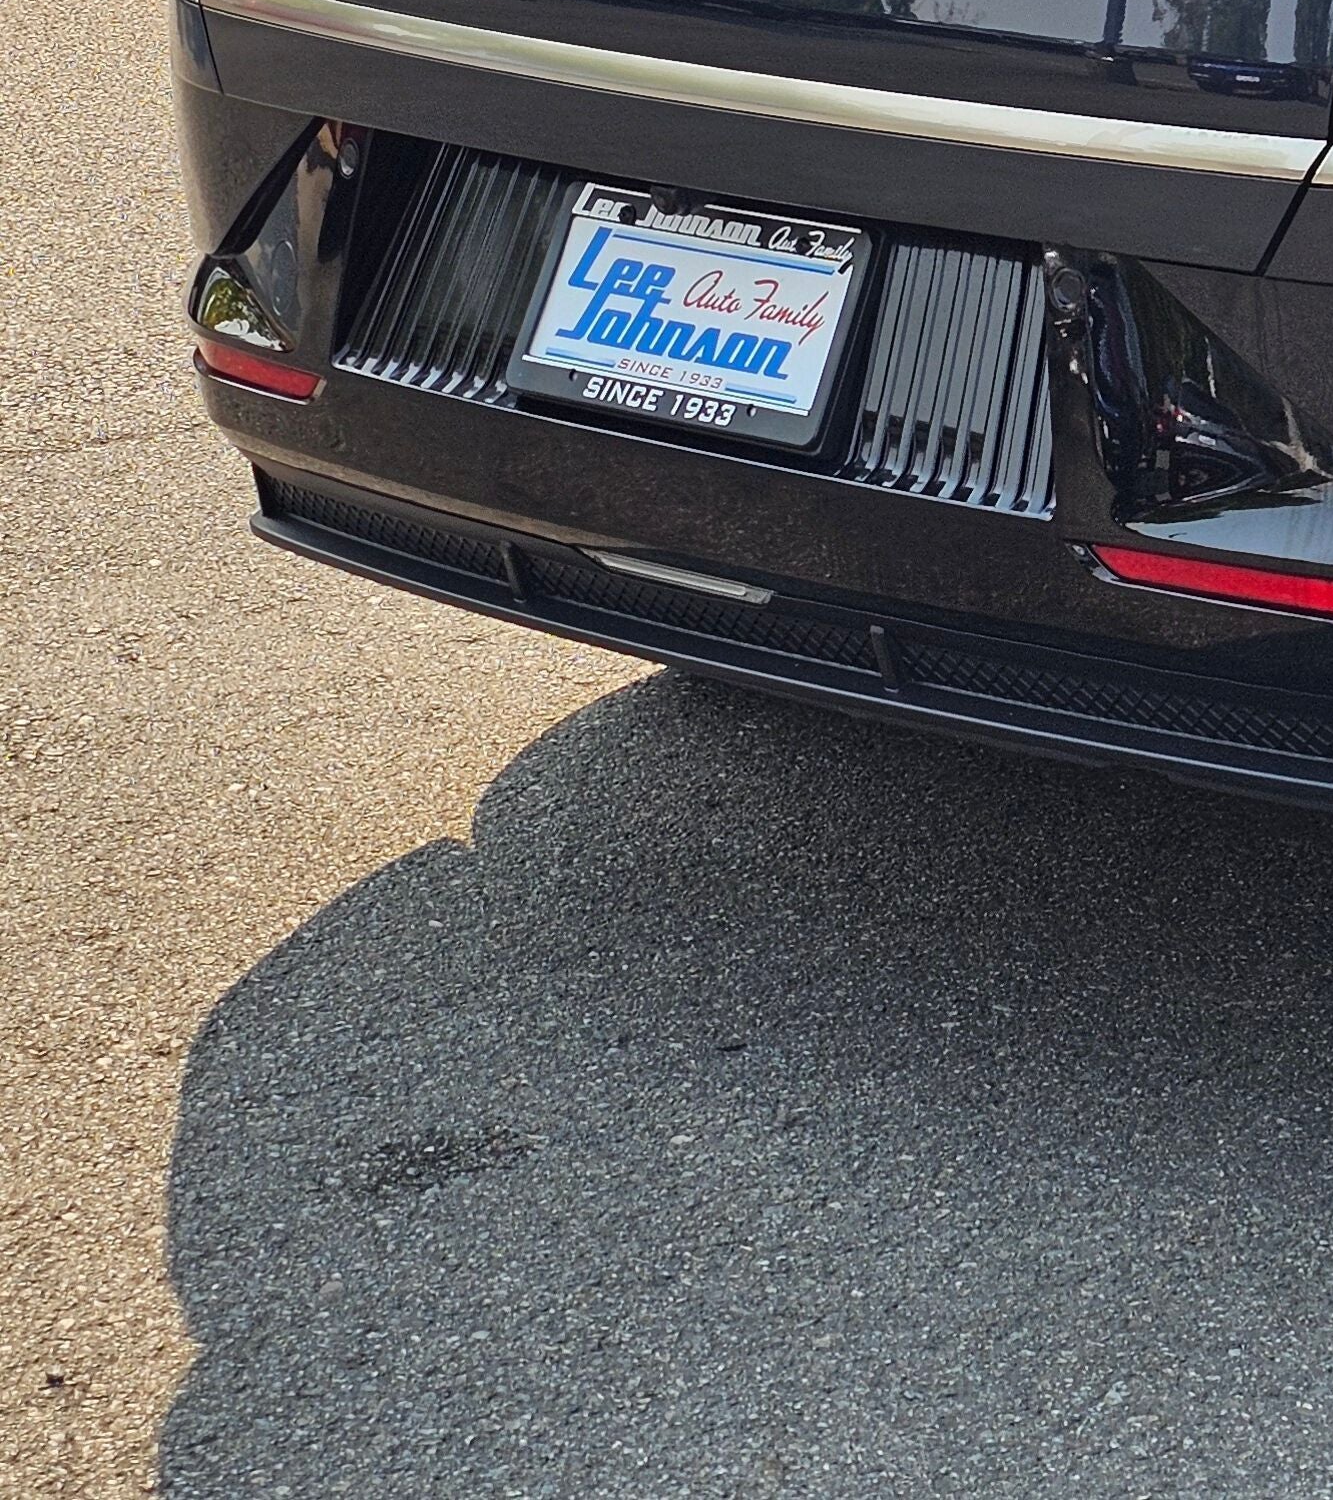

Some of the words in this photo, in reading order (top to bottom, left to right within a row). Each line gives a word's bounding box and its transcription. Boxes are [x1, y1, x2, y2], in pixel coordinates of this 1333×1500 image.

[568, 227, 676, 304] Lee
[555, 287, 793, 380] Johnson
[682, 270, 742, 314] Auto
[744, 279, 829, 346] Family
[583, 377, 664, 412] SINCE
[670, 394, 736, 427] 1933
[617, 358, 673, 380] SINCE
[680, 370, 723, 390] 1933
